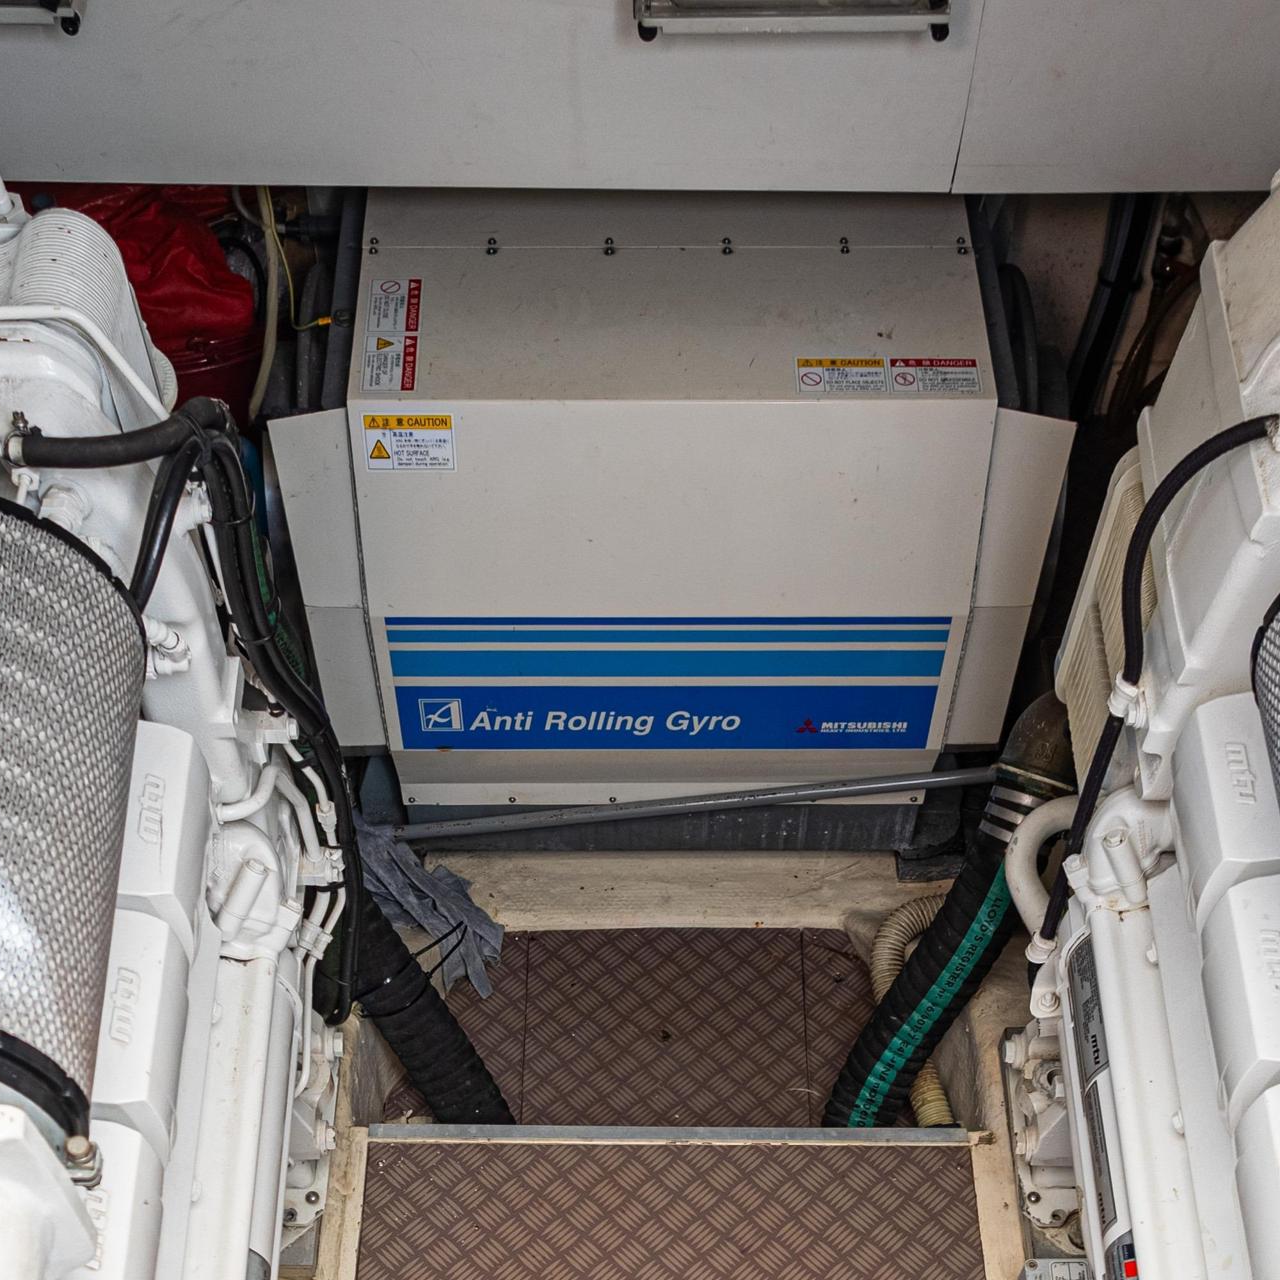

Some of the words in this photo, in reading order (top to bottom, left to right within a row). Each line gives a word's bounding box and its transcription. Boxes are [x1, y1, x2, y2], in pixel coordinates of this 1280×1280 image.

[408, 304, 418, 330] DANGER
[403, 362, 414, 389] DANGER
[407, 417, 448, 427] CAUTION
[394, 449, 405, 457] HOT
[406, 449, 430, 457] SURFACE
[470, 710, 533, 732] Anti
[544, 711, 655, 735] Rolling
[665, 710, 742, 736] Gyro
[1225, 742, 1258, 804] mtu
[137, 773, 167, 845] mtu
[974, 896, 1002, 944] LLOYD'S
[946, 943, 979, 988] REGISTER
[109, 967, 141, 1046] mtu
[1090, 1032, 1103, 1066] mtu
